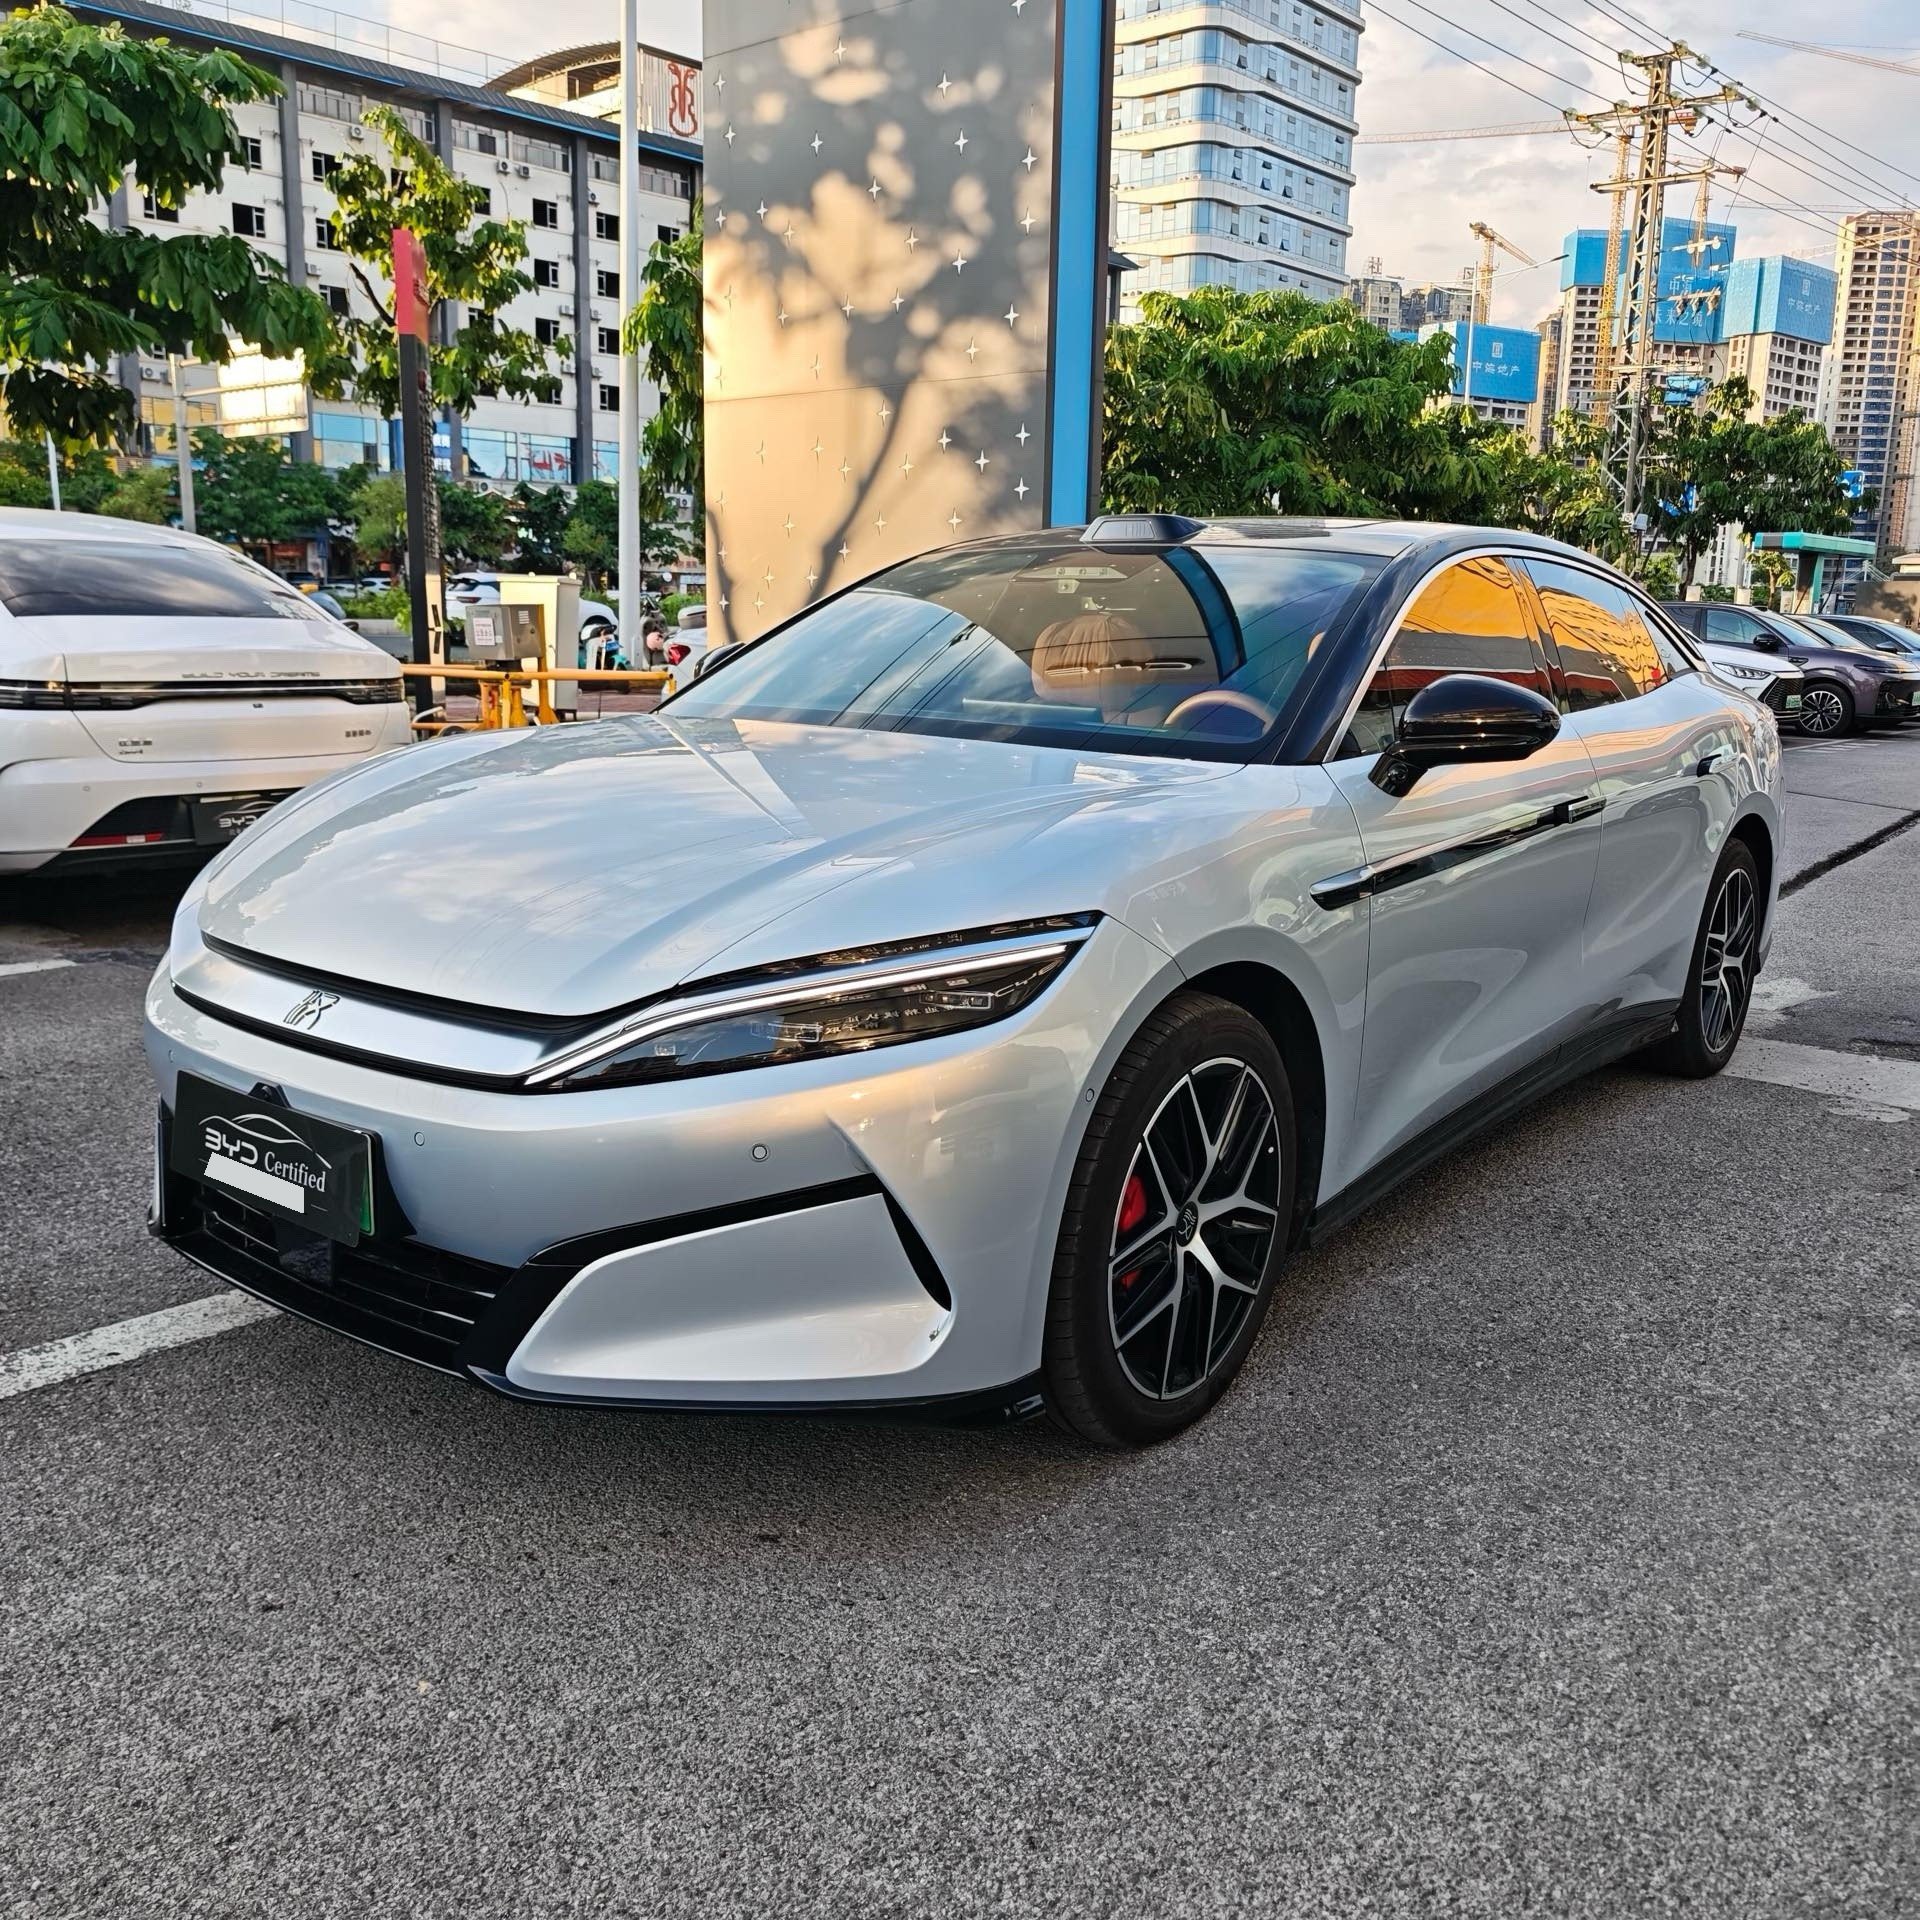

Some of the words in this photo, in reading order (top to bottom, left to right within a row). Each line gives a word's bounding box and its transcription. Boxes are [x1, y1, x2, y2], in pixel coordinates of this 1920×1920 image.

[1472, 361, 1520, 377] 中海地产
[218, 815, 257, 829] BYD
[204, 1127, 258, 1166] BYD
[263, 1150, 326, 1193] Certified
